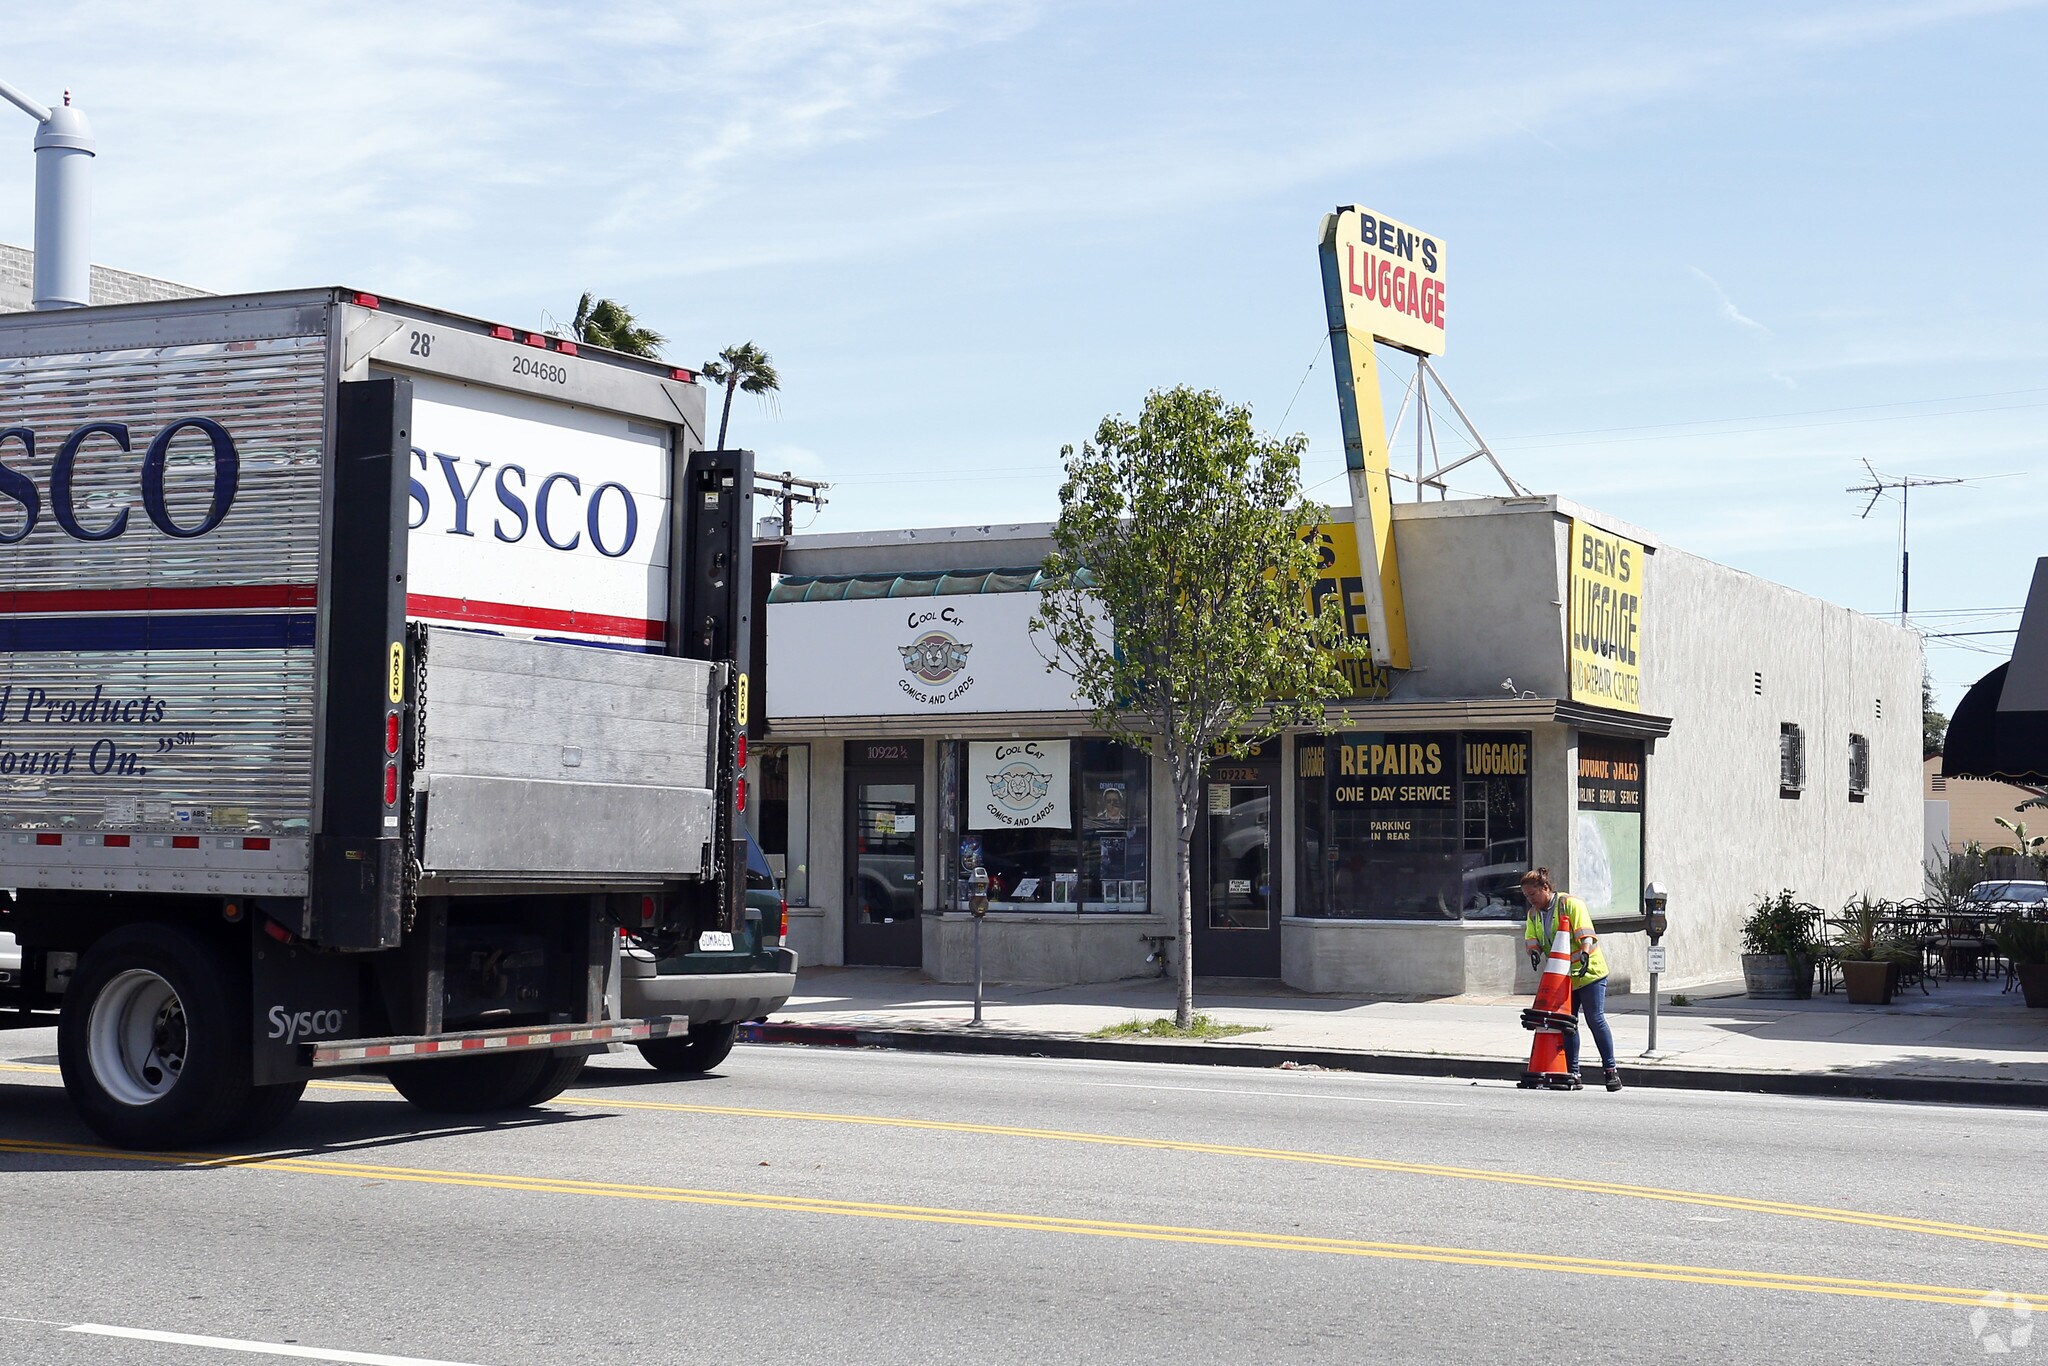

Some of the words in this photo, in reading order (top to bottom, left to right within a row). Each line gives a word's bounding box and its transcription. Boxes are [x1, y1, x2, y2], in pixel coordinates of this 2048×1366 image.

[1360, 213, 1438, 273] BEN'S
[1349, 245, 1445, 330] LUGGAGE
[512, 356, 567, 385] 204680
[1582, 533, 1631, 583] BEN'S
[1574, 574, 1638, 667] LUGGAGE
[392, 650, 400, 696] MAXON
[898, 679, 927, 703] COMICS
[928, 694, 946, 705] AND
[948, 675, 975, 701] CARDS
[1586, 663, 1612, 698] REPAIR
[1613, 671, 1640, 705] CENTER
[19, 684, 167, 723] Products
[0, 739, 76, 776] ount
[867, 746, 899, 759] 10922
[1300, 746, 1325, 777] LUGGAGE
[1340, 743, 1442, 775] REPAIRS
[1466, 743, 1527, 775] LUGGAGE
[1217, 769, 1247, 780] 10922
[1336, 787, 1364, 801] ONE
[1371, 787, 1396, 801] DAY
[1400, 786, 1450, 801] SERVICE
[986, 804, 1013, 825] COMICS
[1013, 817, 1030, 826] AND
[1031, 802, 1055, 823] CARDS
[1370, 821, 1411, 831] PARKING
[1371, 832, 1381, 841] IN
[1387, 832, 1410, 841] REAR
[268, 1005, 342, 1045] Sysco
